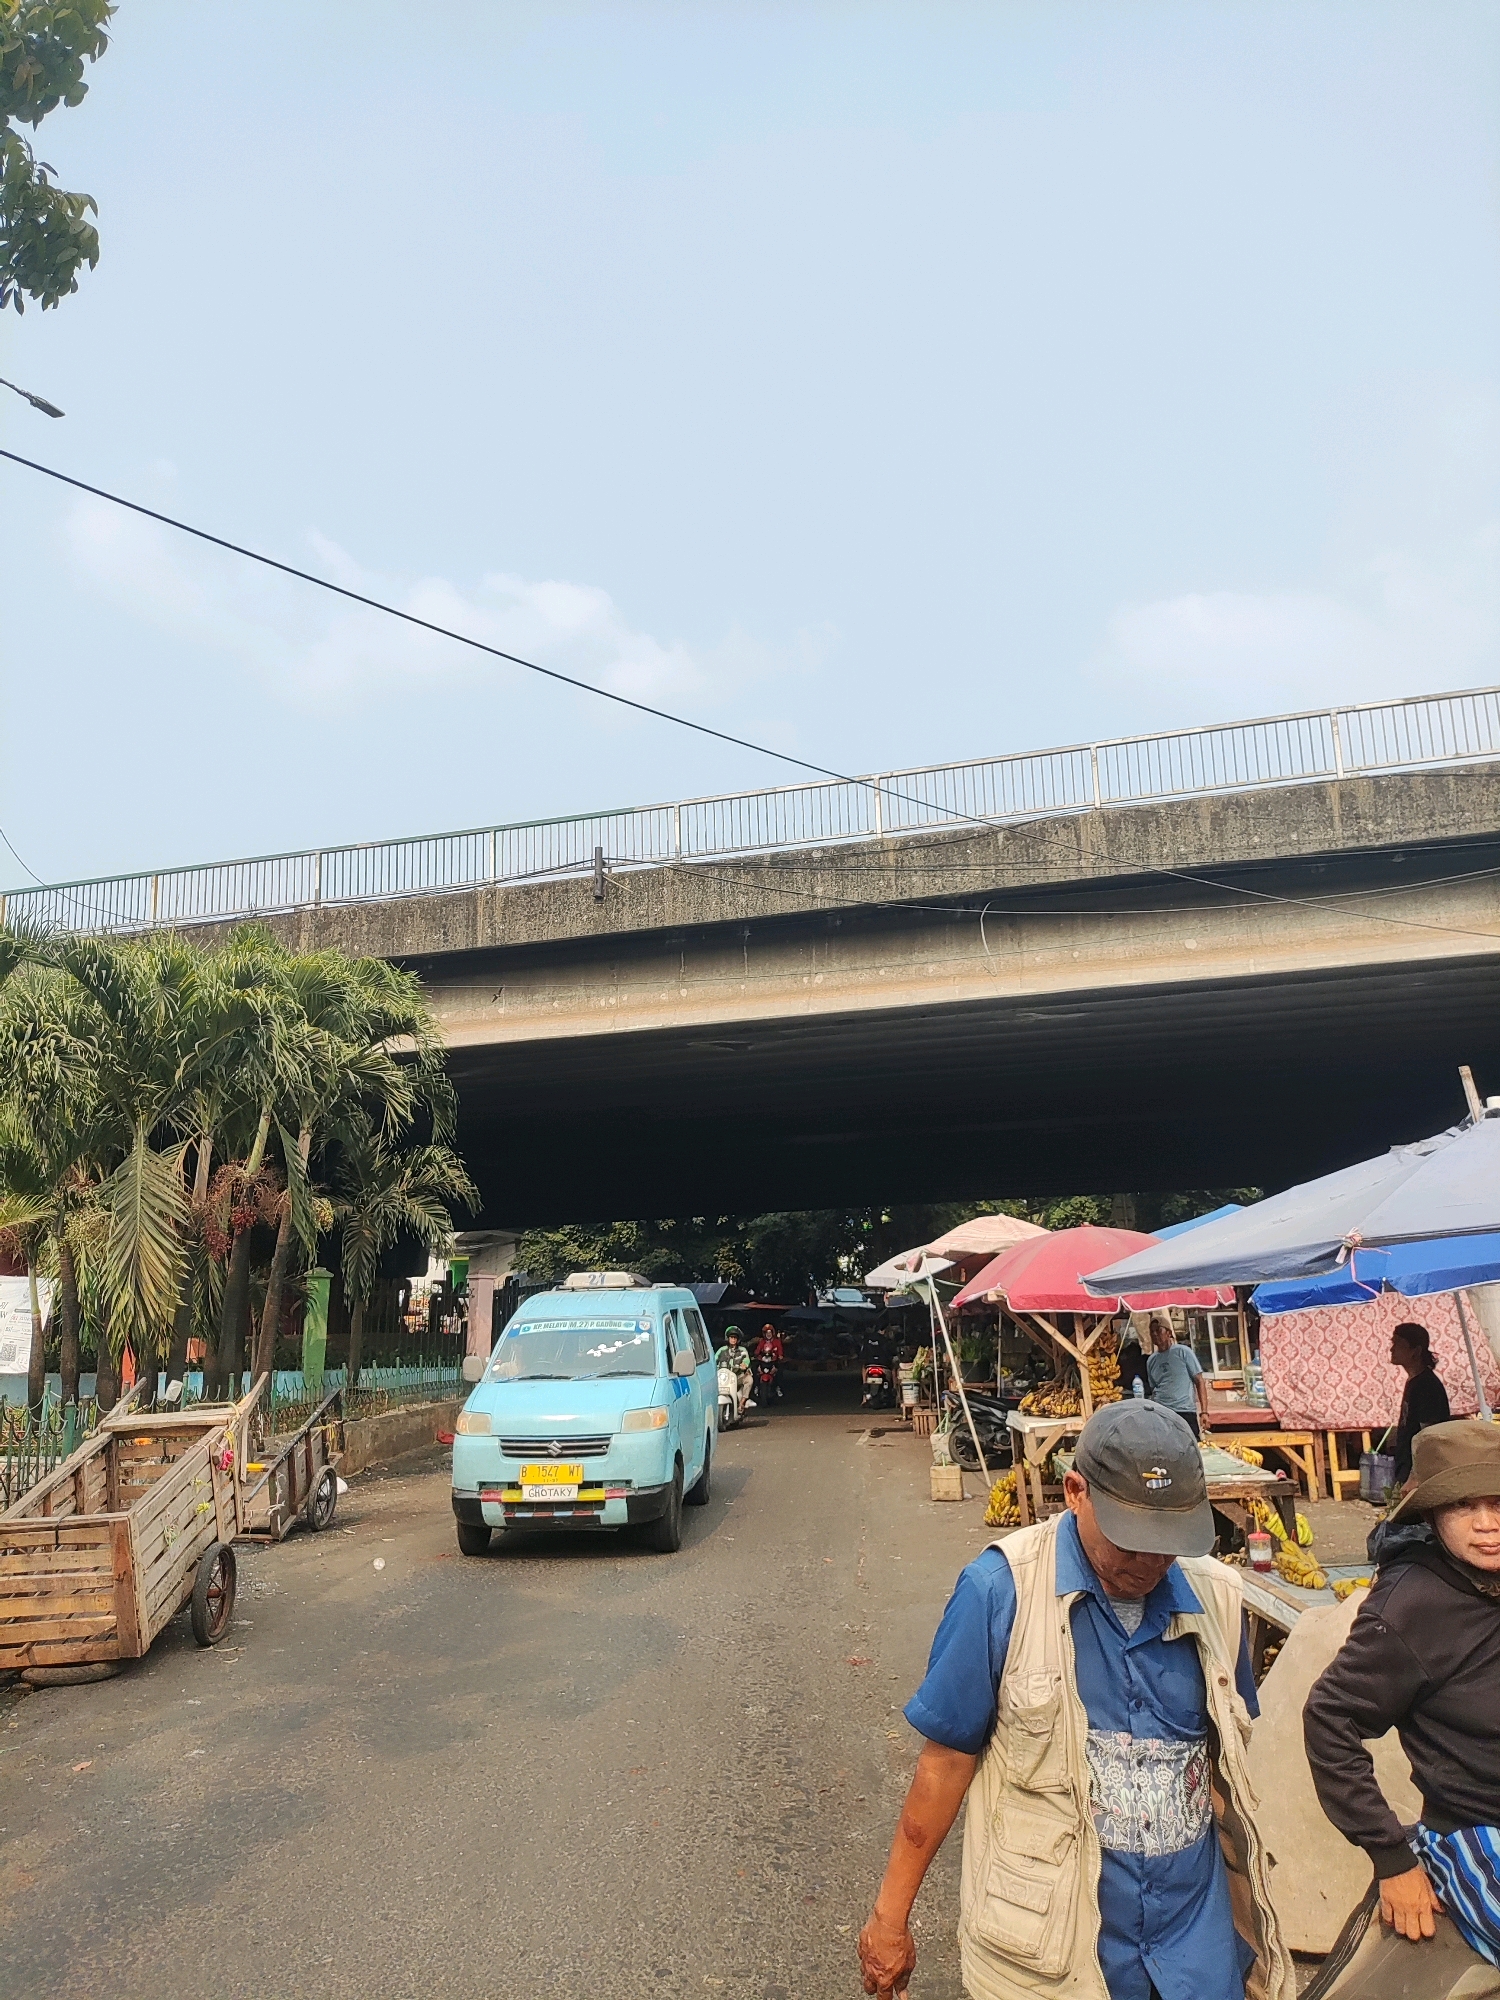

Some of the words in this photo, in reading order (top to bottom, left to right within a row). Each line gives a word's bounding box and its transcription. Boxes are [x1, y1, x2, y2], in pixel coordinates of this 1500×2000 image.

[543, 1321, 568, 1329] MELAYU
[521, 1466, 528, 1478] B
[537, 1465, 560, 1477] 1547
[568, 1465, 581, 1477] WT
[528, 1488, 573, 1498] GHOTAKY
